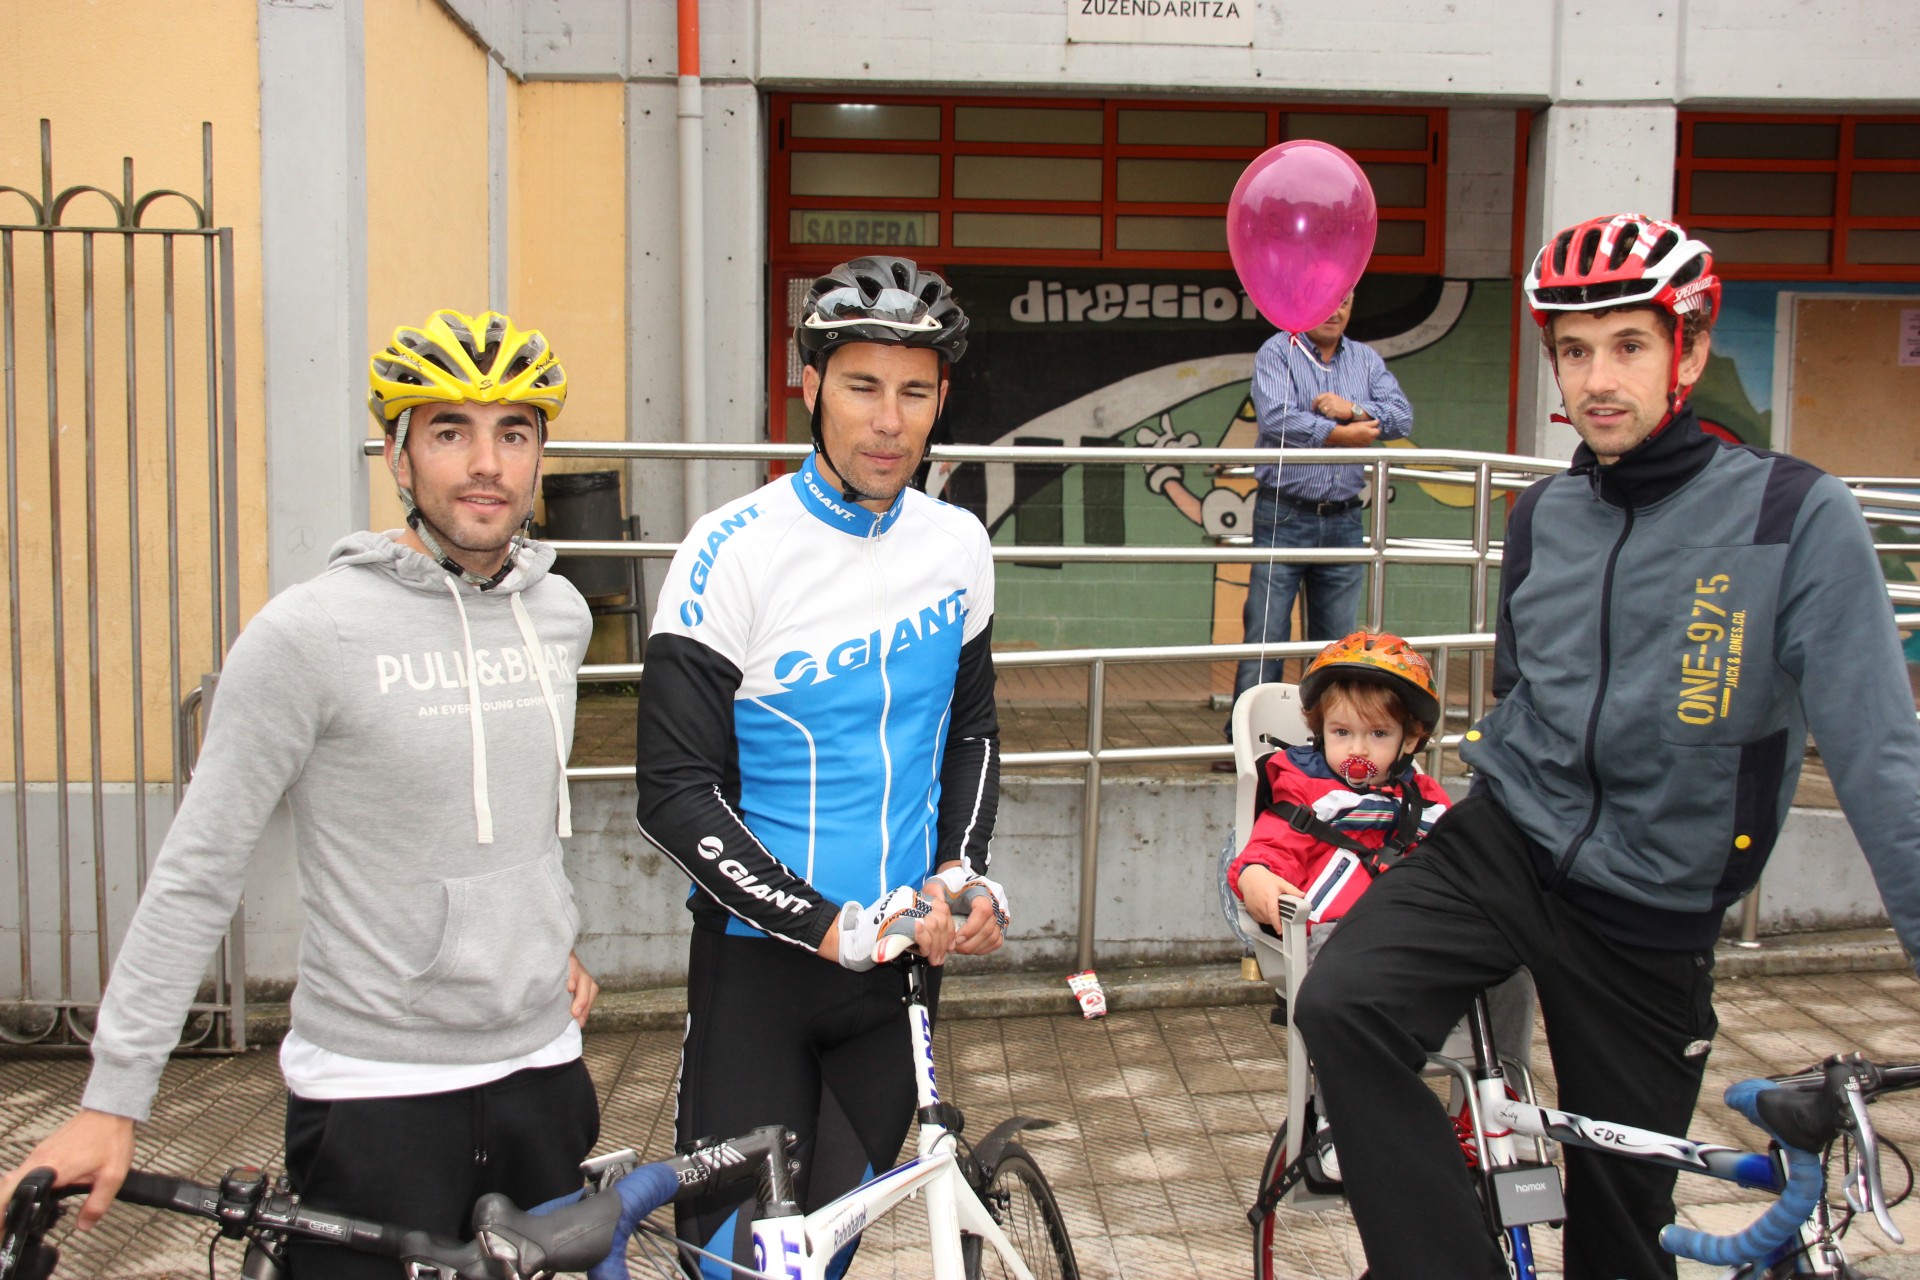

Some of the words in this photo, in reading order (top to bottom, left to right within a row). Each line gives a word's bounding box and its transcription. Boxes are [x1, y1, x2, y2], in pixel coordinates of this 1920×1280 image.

[1081, 0, 1241, 19] ZUZENDARITZA
[807, 217, 918, 246] SARRERA
[808, 484, 856, 521] GIANT
[689, 503, 760, 596] GIANT
[826, 588, 968, 677] GIANT
[1676, 573, 1731, 726] ONE-975
[1728, 656, 1741, 665] &
[1724, 664, 1740, 689] JACK
[418, 705, 438, 717] AN
[478, 699, 514, 712] OUNG
[718, 859, 813, 914] GIANT
[1515, 1182, 1547, 1193] hamax
